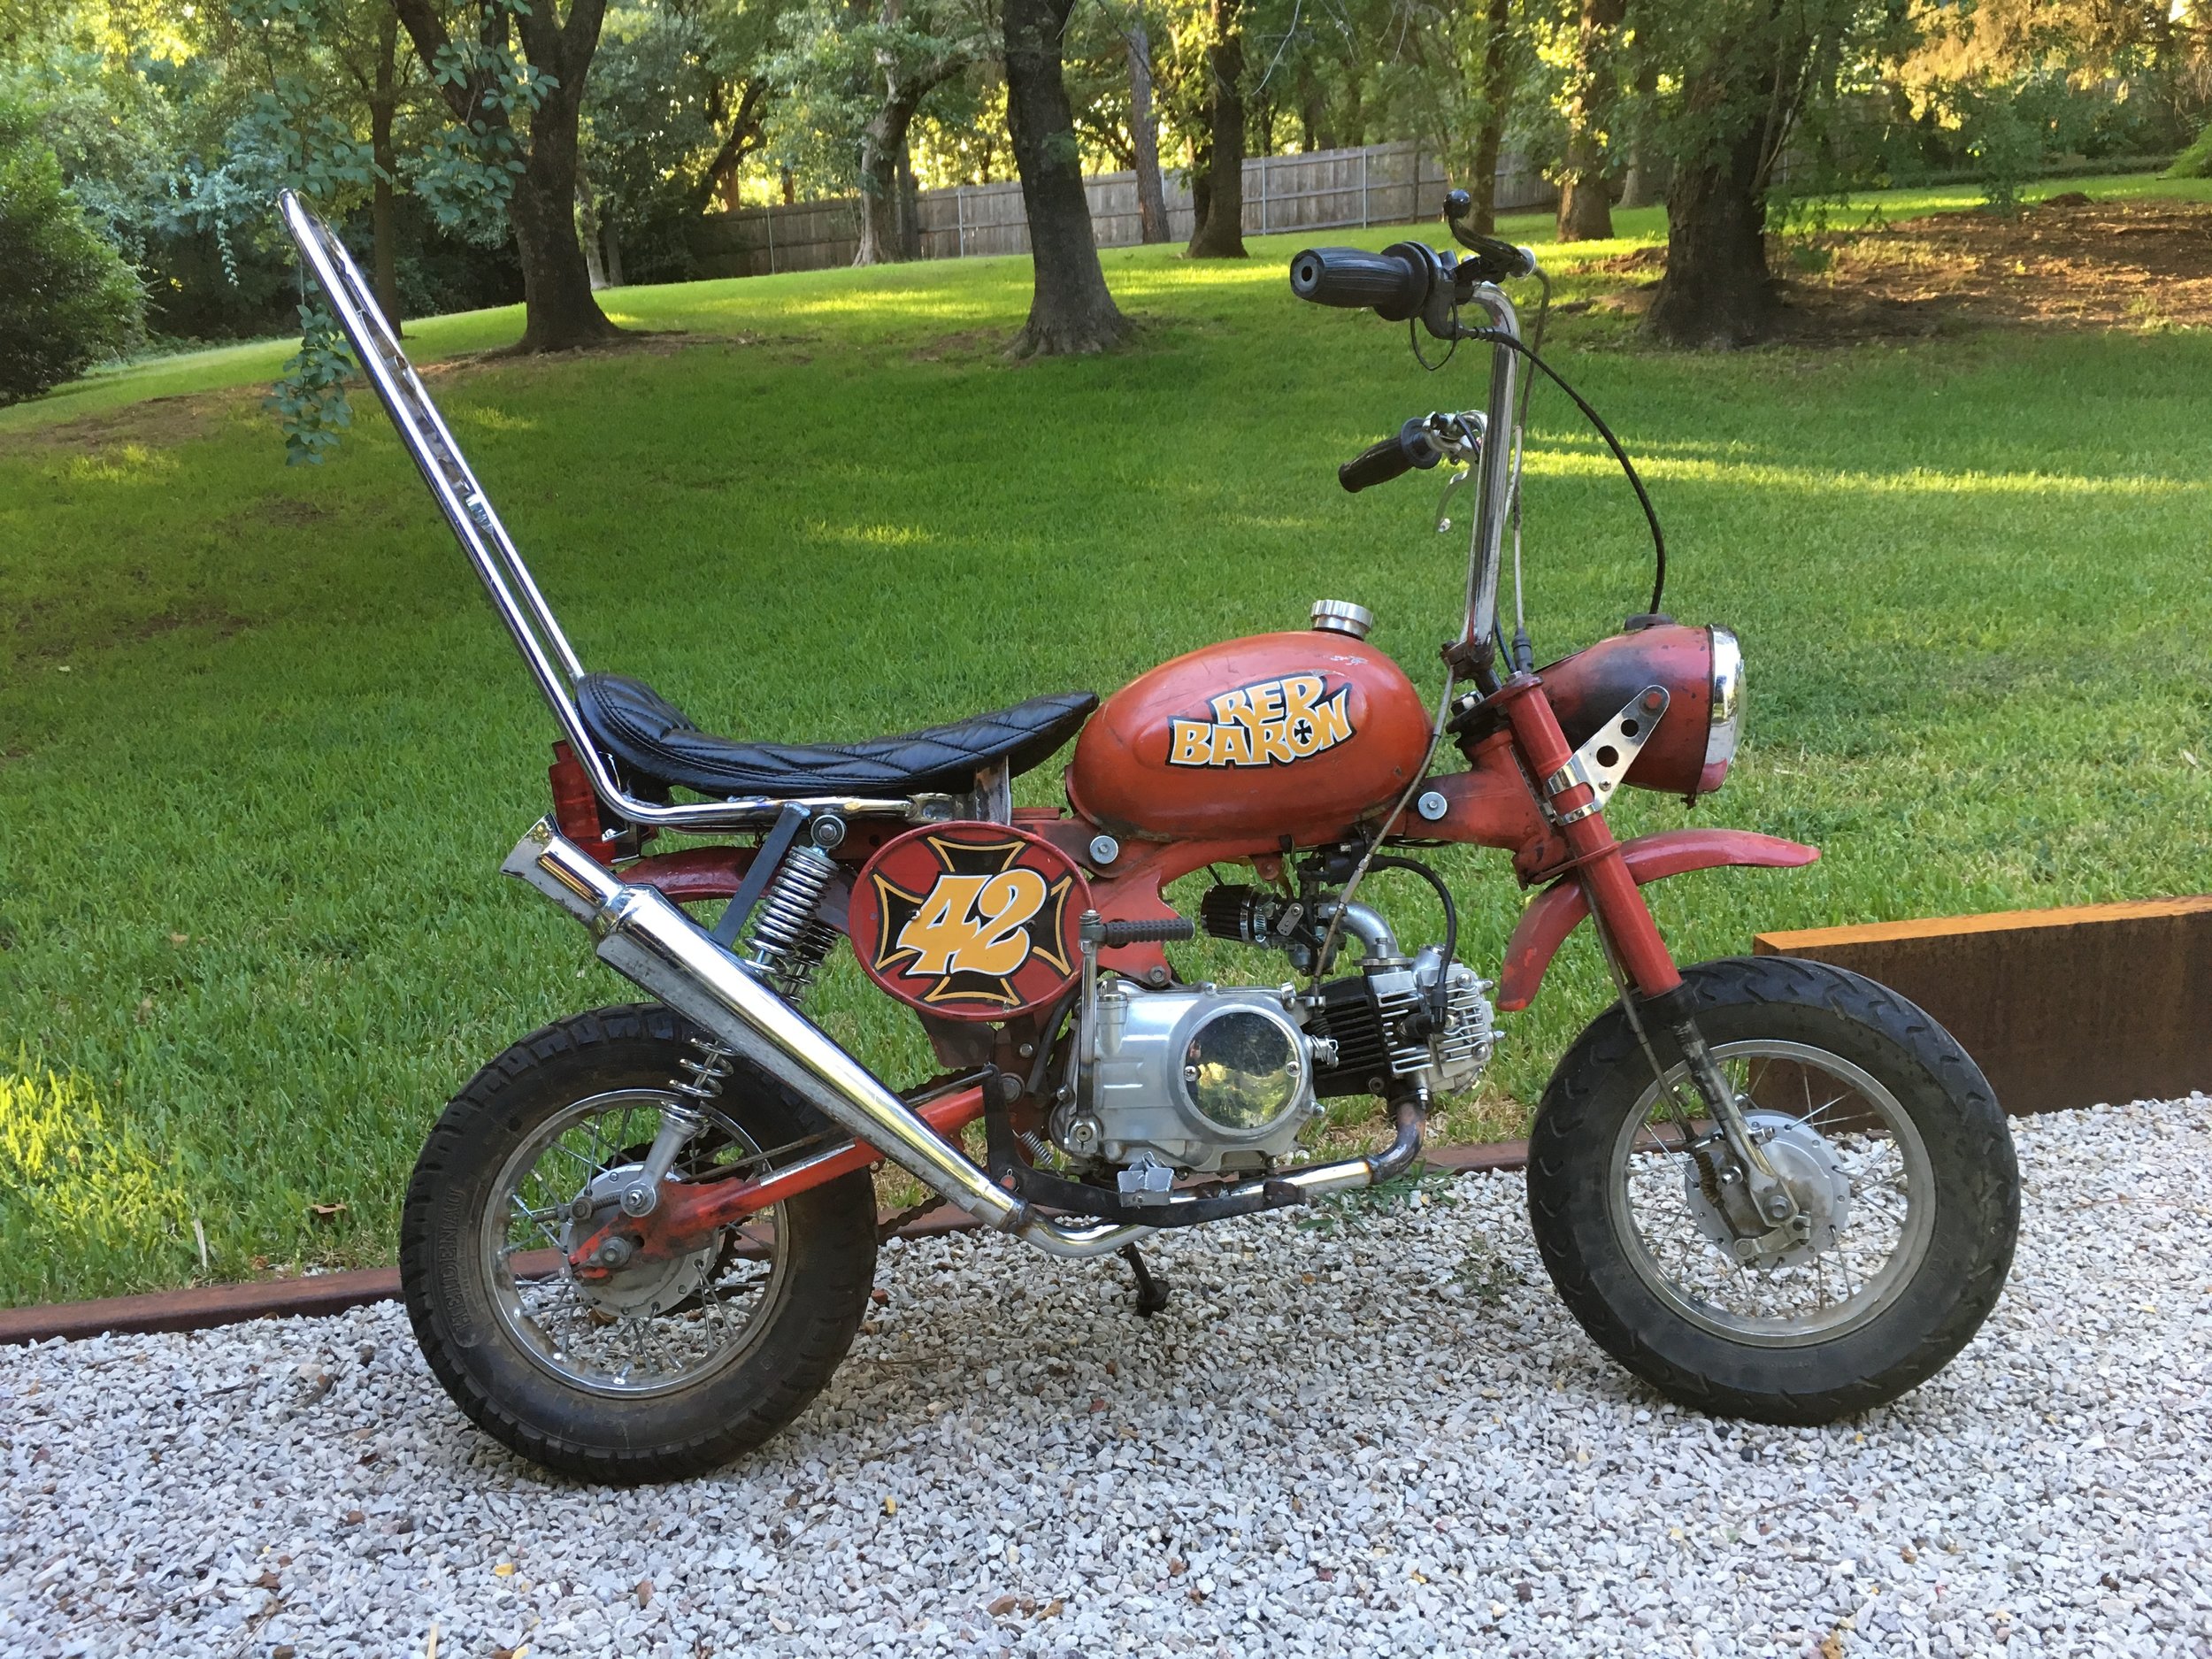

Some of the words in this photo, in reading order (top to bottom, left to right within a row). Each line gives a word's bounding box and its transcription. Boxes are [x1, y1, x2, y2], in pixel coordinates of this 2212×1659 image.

[1169, 687, 1353, 766] BARON
[1210, 674, 1325, 726] RED
[895, 868, 1048, 976] 42
[439, 1187, 472, 1331] HEIDENAU
